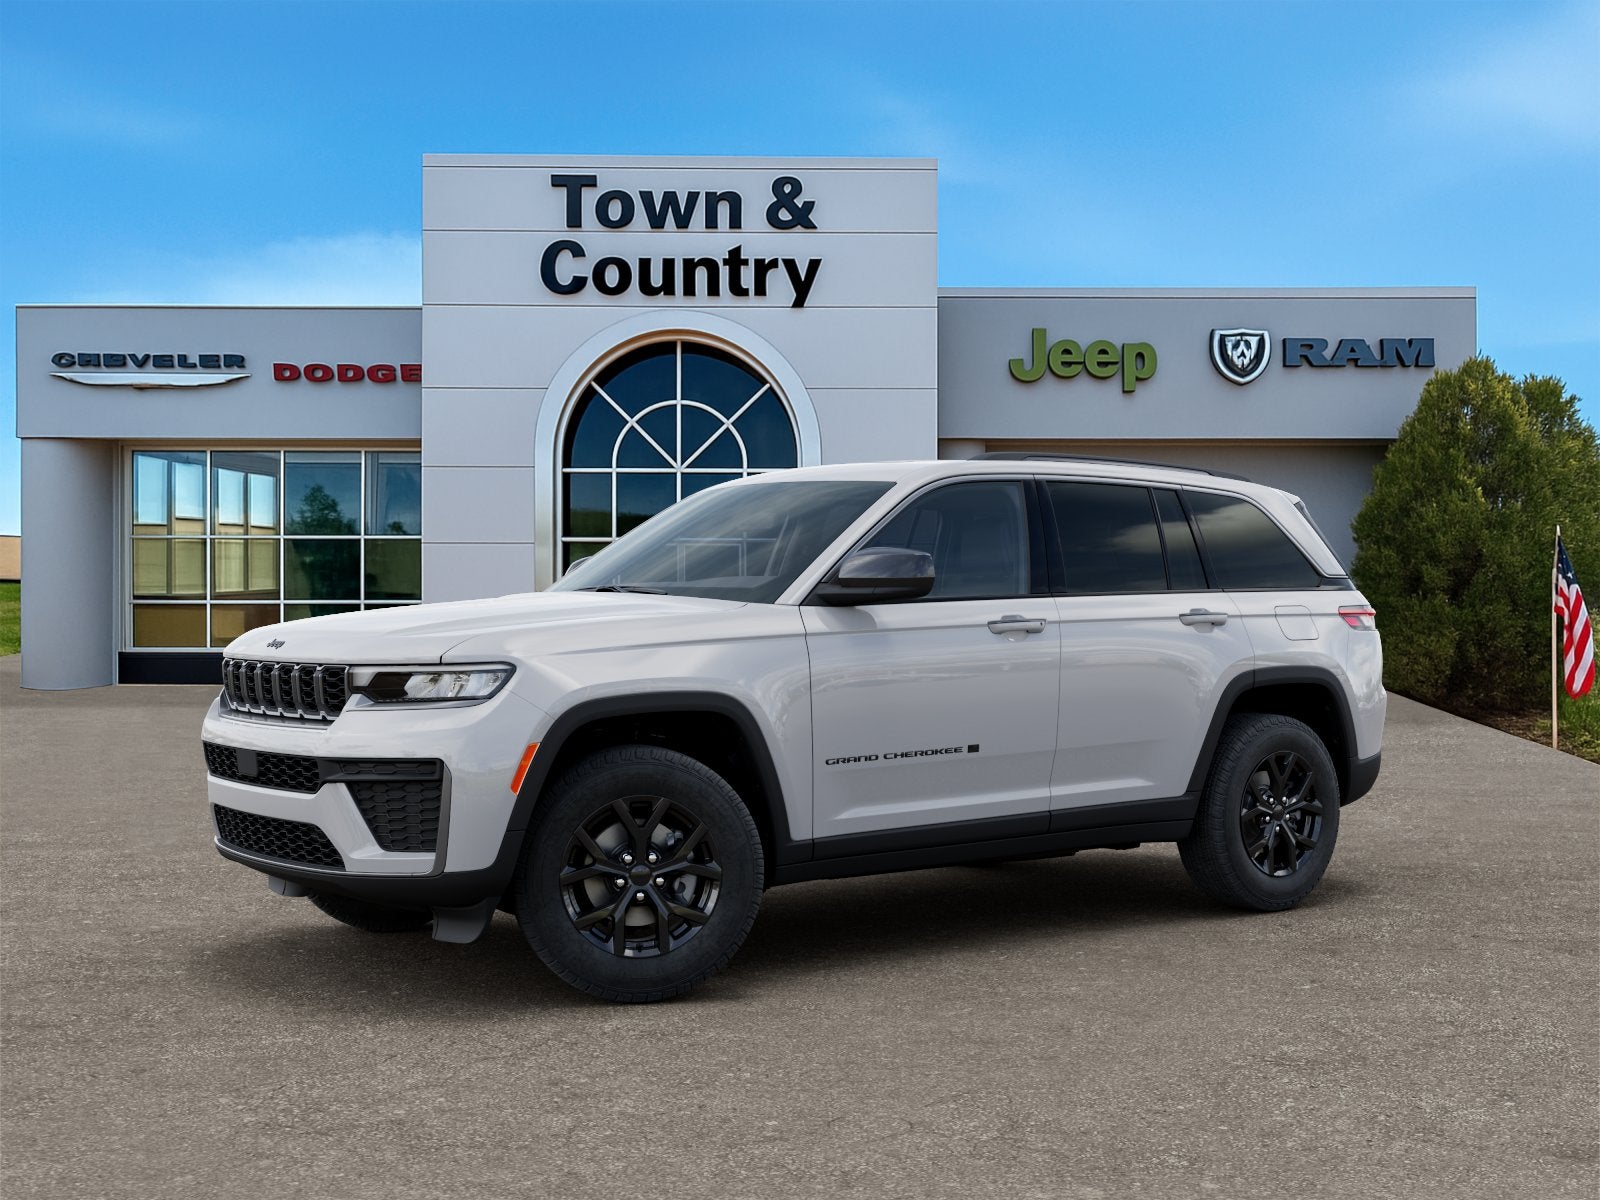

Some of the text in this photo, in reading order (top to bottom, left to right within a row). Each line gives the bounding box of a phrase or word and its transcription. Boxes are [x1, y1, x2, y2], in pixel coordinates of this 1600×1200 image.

[550, 174, 818, 230] Town &
[540, 239, 822, 308] Country
[273, 363, 422, 383] DODGE
[1009, 328, 1157, 392] Jeep
[1283, 338, 1435, 367] RAM
[825, 746, 963, 766] GRAND CHEROKEE
